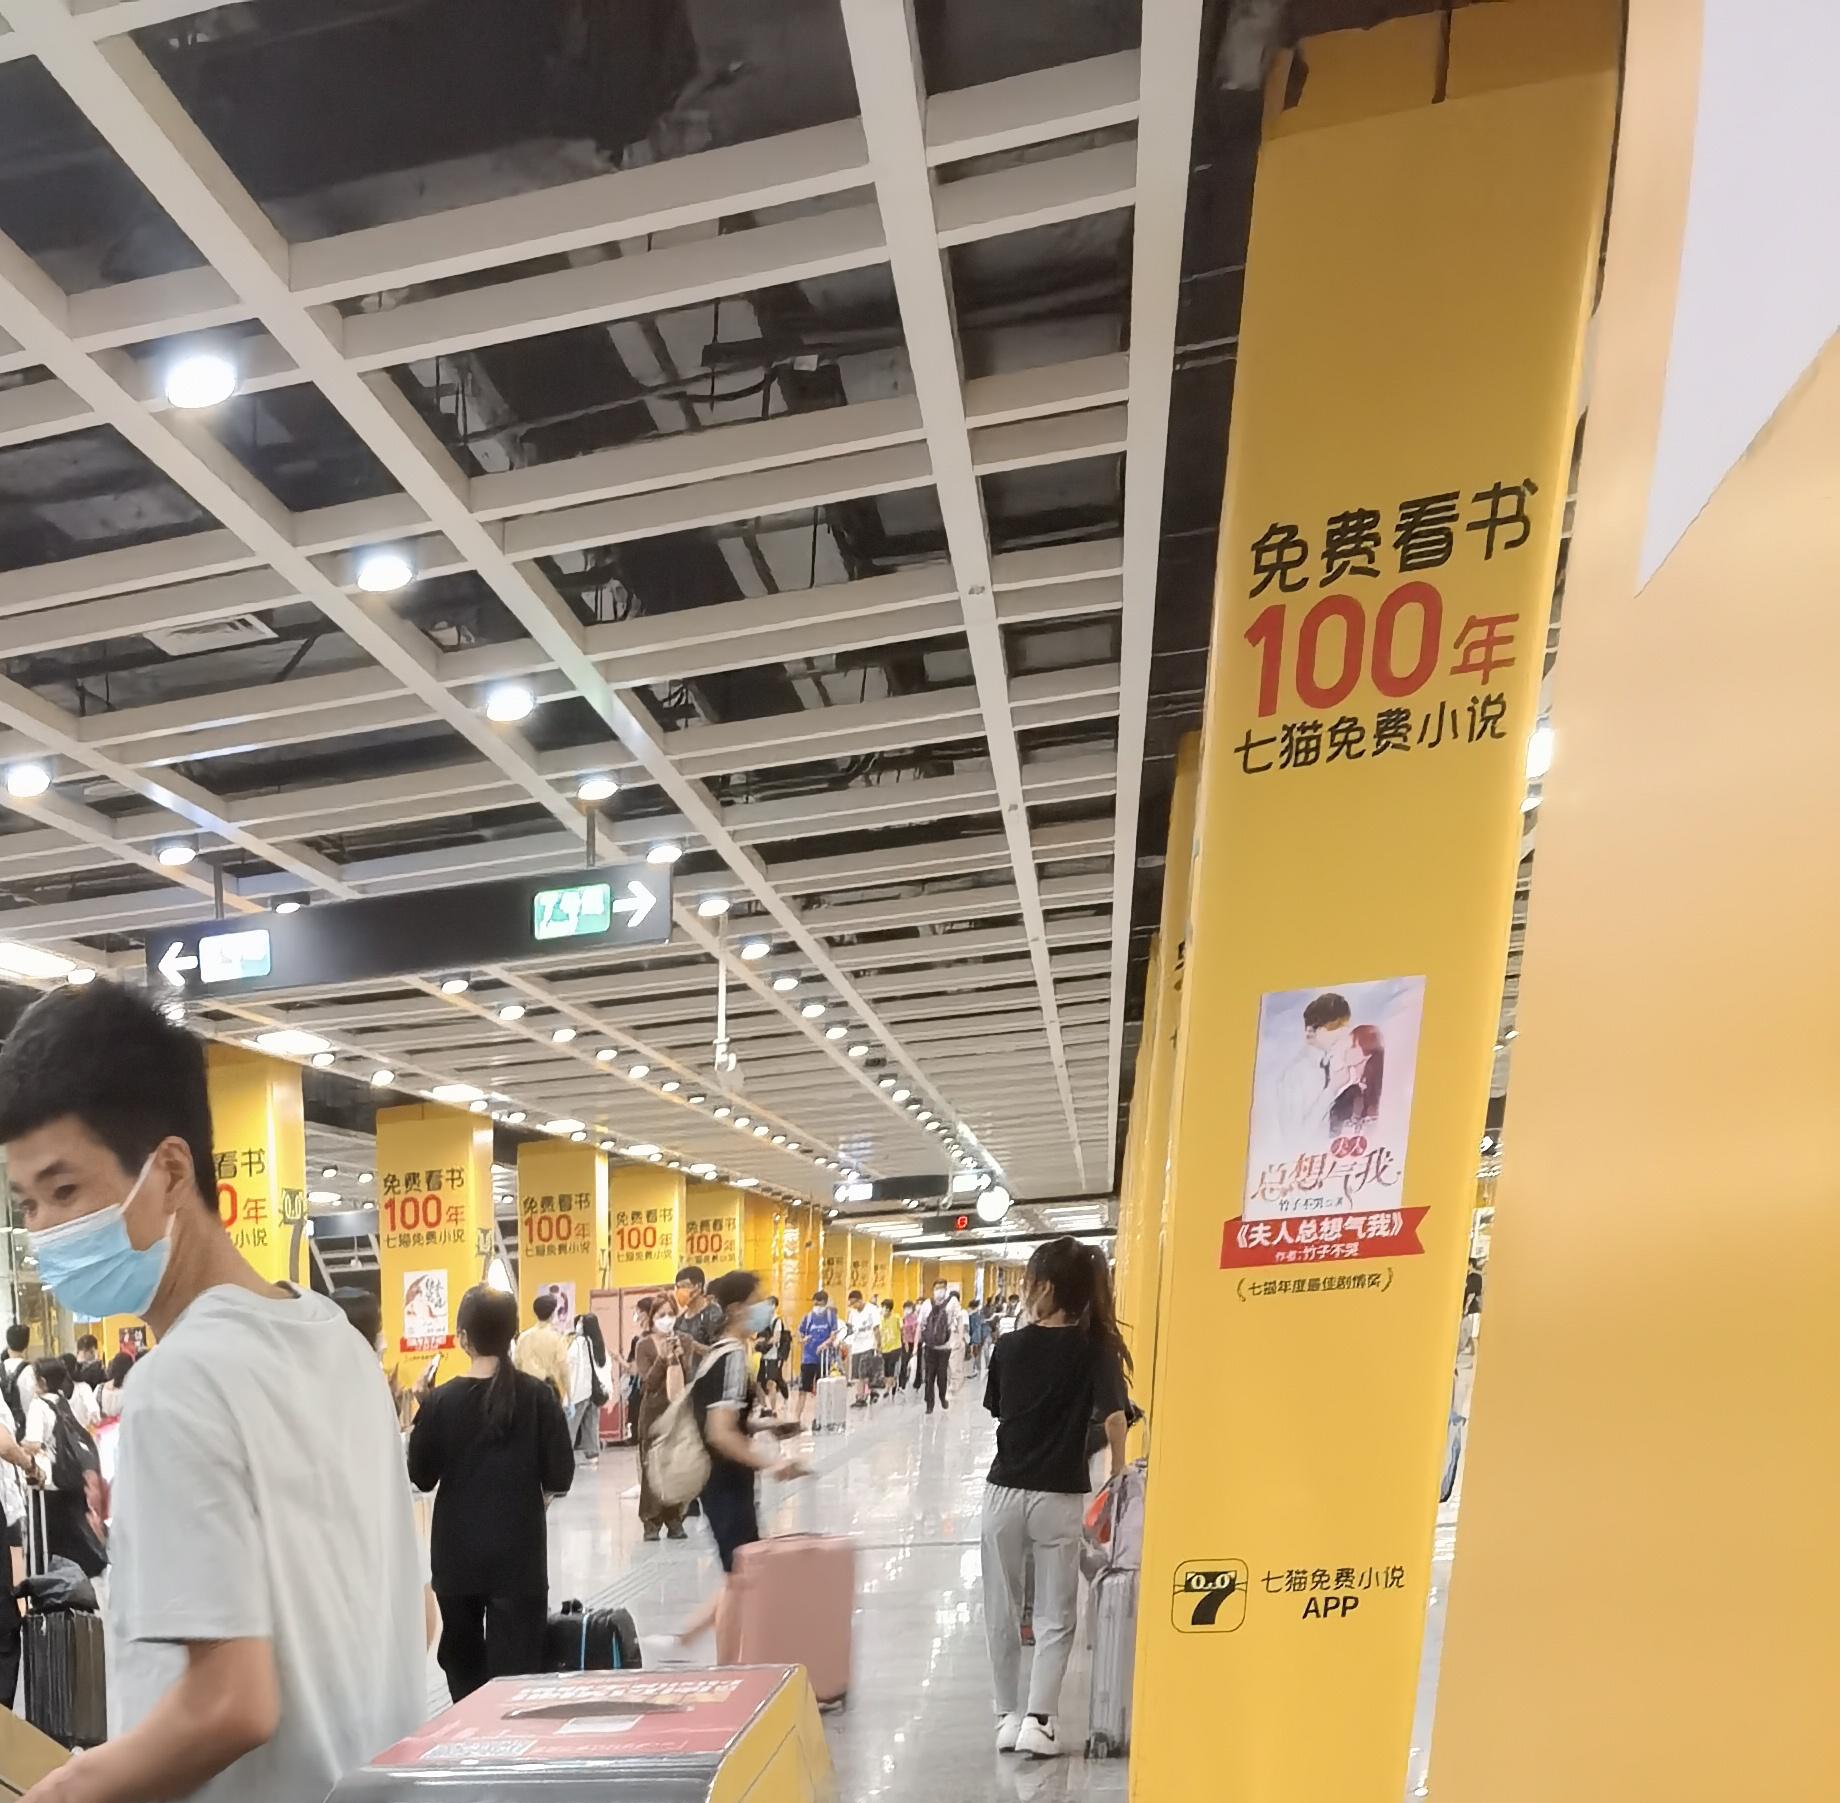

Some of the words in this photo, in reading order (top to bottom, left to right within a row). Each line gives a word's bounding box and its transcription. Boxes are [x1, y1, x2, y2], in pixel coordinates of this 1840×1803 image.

[1248, 477, 1539, 600] 免费看书
[1243, 580, 1520, 718] 100年
[1233, 691, 1508, 775] 七猫免费小说
[382, 1167, 465, 1196] 免费看书
[384, 1193, 466, 1232] 100年
[1260, 1564, 1406, 1593] 七猫免费小说
[1302, 1595, 1360, 1620] APP
